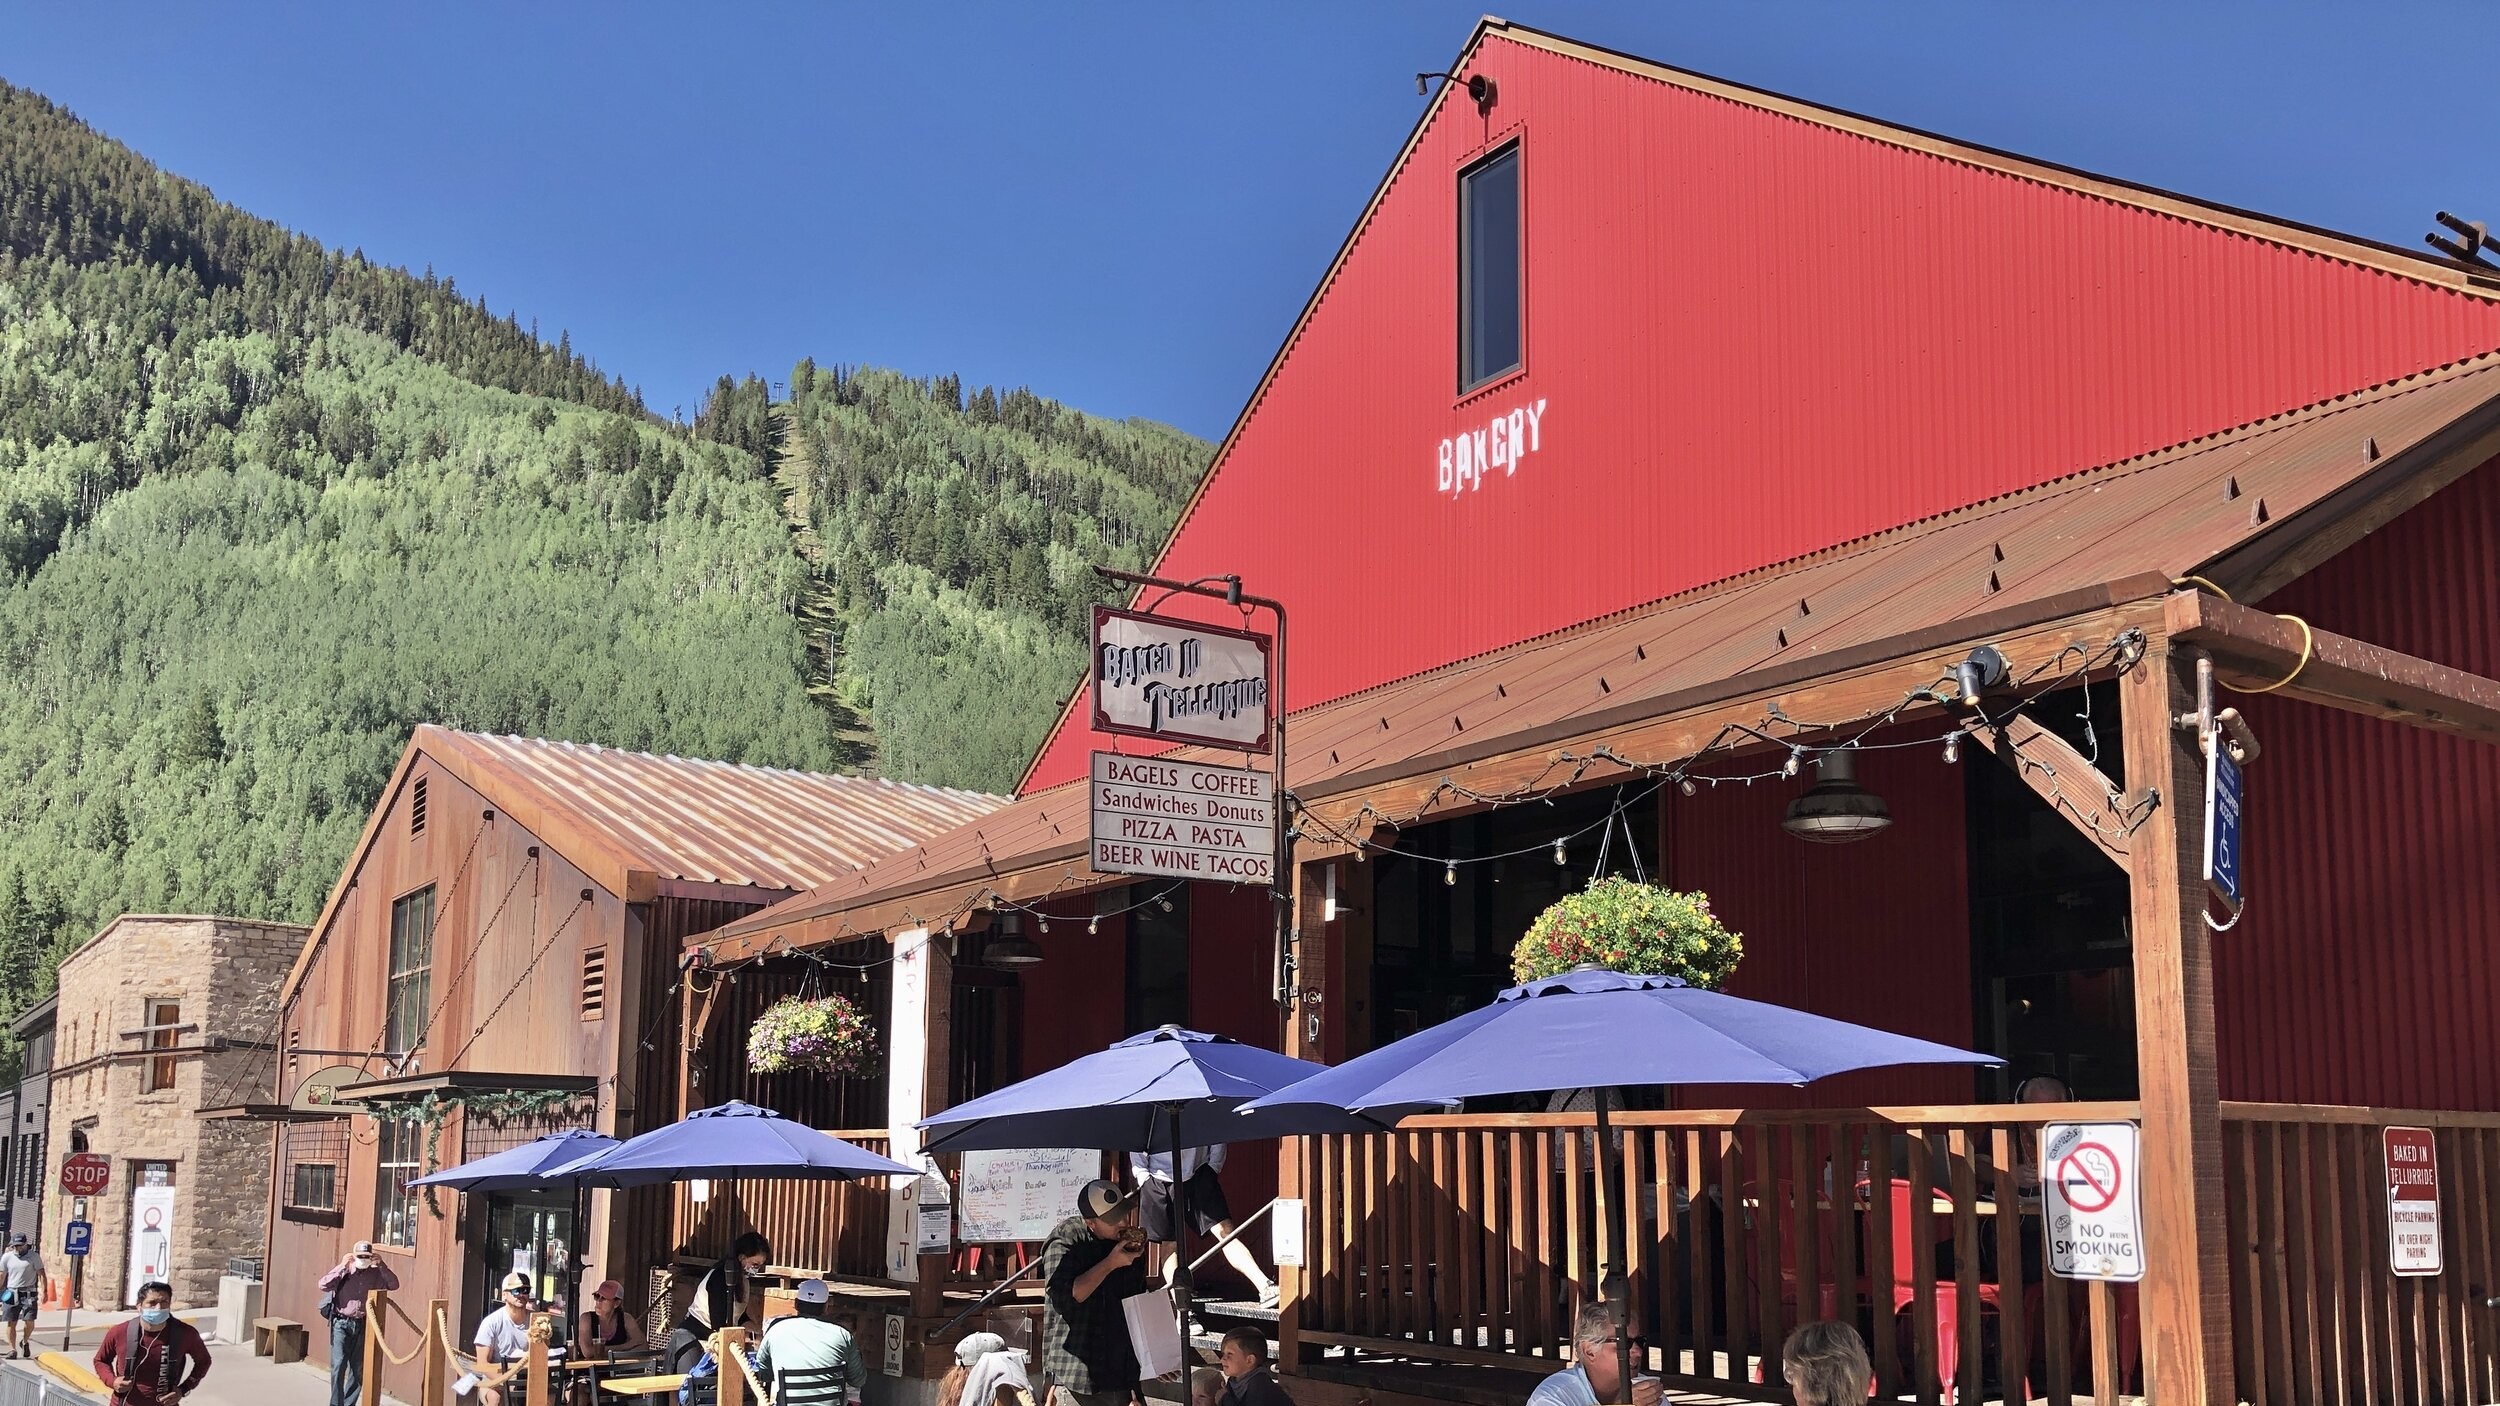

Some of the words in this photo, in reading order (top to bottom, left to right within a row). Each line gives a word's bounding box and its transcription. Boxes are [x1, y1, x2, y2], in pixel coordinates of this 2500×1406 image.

[1438, 399, 1547, 500] BAKERY
[1101, 641, 1174, 687] BAKED
[1179, 638, 1202, 678] IN
[1144, 676, 1268, 733] TELLURIDE
[1108, 761, 1178, 788] BAGELS
[1191, 771, 1259, 797] COFFEE
[1102, 788, 1198, 816] Sandwiches
[1207, 800, 1265, 823] Donuts
[1122, 818, 1178, 842] PIZZA
[1192, 825, 1246, 848] PASTA
[1100, 844, 1143, 866] BEER
[1151, 848, 1201, 871] WINE
[1207, 854, 1268, 878] TACOS
[2393, 1145, 2417, 1162] BAKED
[2419, 1146, 2428, 1162] IN
[64, 1166, 107, 1183] STOP
[2390, 1167, 2434, 1185] TELLURRIDE
[2394, 1211, 2414, 1223] BICYCLE
[2415, 1211, 2435, 1223] PARKING
[69, 1226, 88, 1245] P
[2080, 1224, 2104, 1238] NO
[2398, 1234, 2405, 1245] NO
[2407, 1234, 2419, 1245] OVER
[2420, 1234, 2433, 1245] NIGHT
[2056, 1240, 2133, 1257] SMOKING
[2406, 1247, 2427, 1259] PARKING
